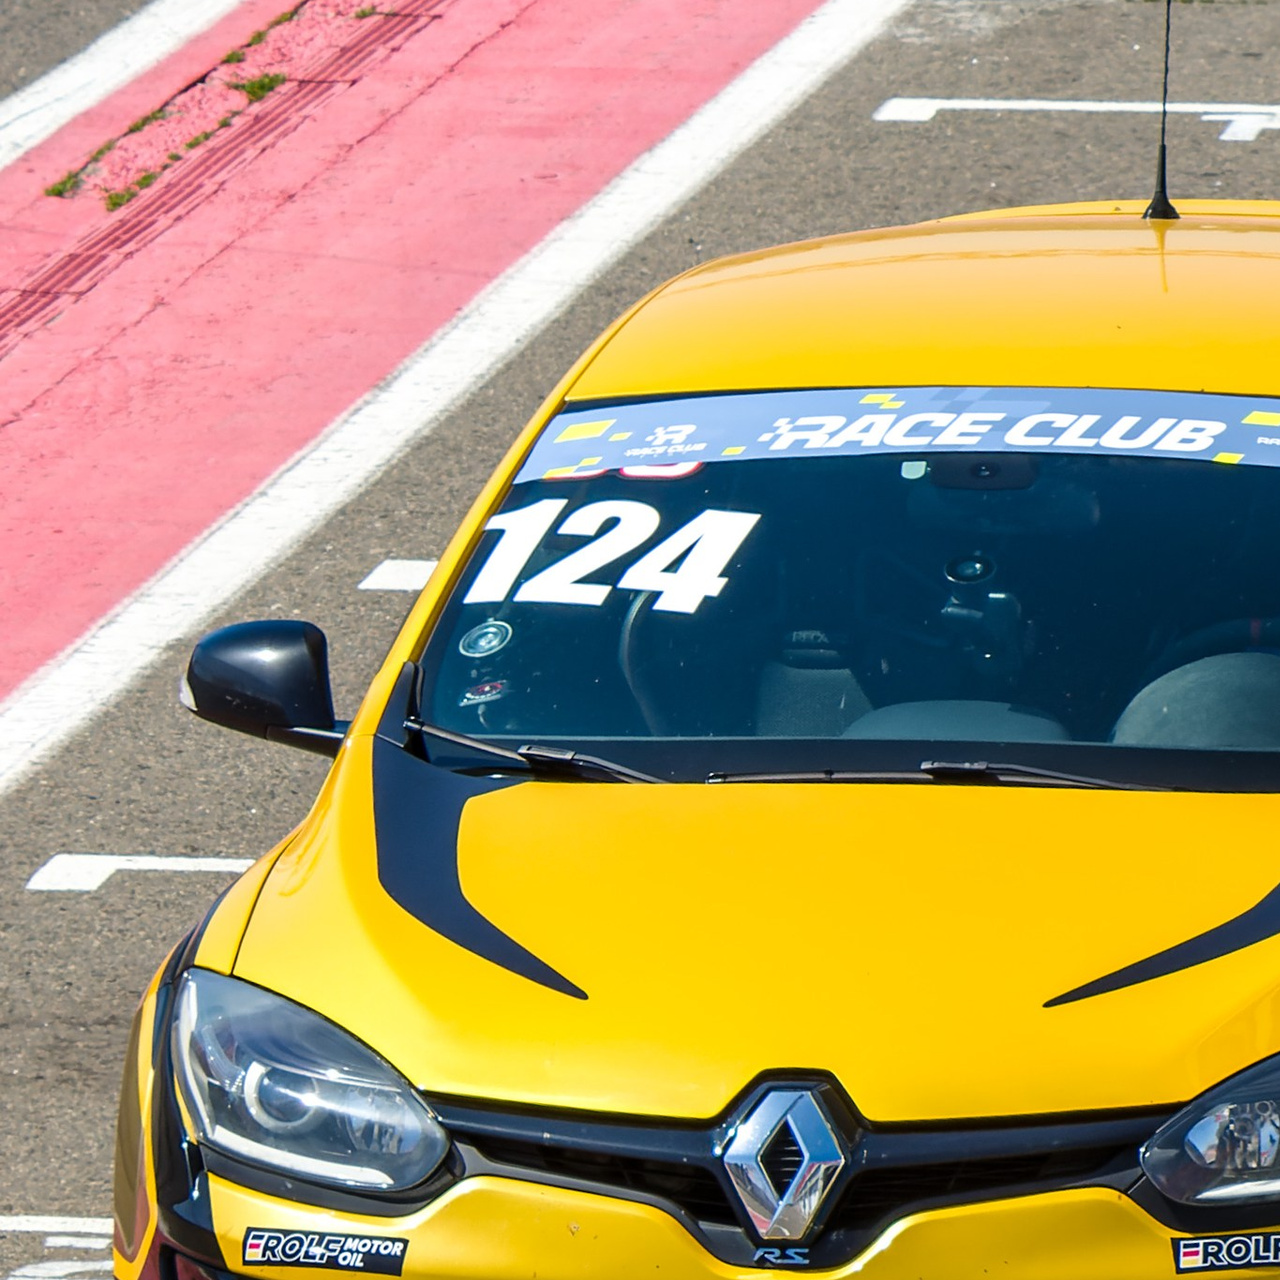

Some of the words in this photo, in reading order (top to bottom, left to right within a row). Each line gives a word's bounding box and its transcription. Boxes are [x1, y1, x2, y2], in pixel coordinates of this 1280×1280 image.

[757, 412, 1006, 452] RACE
[1003, 414, 1227, 453] CLUB
[463, 498, 762, 615] 124
[261, 1232, 346, 1263] ROLF
[343, 1237, 404, 1256] MOTOR
[337, 1251, 365, 1268] OIL
[753, 1247, 810, 1265] RS
